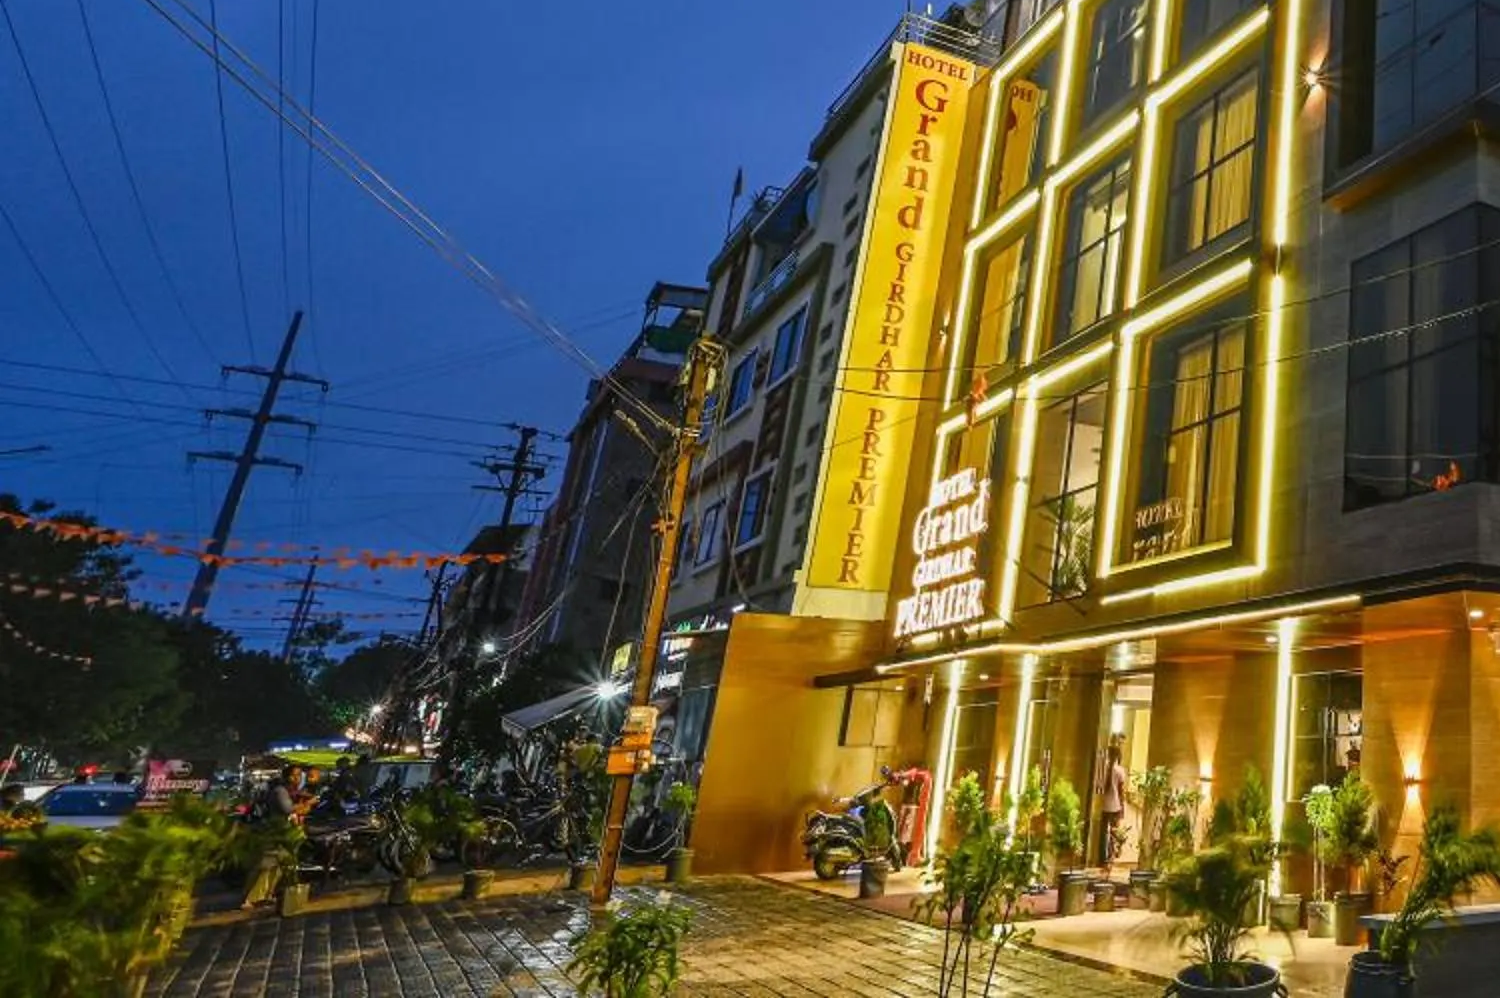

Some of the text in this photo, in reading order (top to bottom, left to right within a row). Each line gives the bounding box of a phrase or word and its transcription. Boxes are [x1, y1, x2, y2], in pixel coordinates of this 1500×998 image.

[908, 49, 968, 82] HOTEL
[837, 78, 949, 584] Grand GIRDHAR PREMIER
[912, 477, 992, 555] Grand
[894, 578, 986, 639] PREMIER
